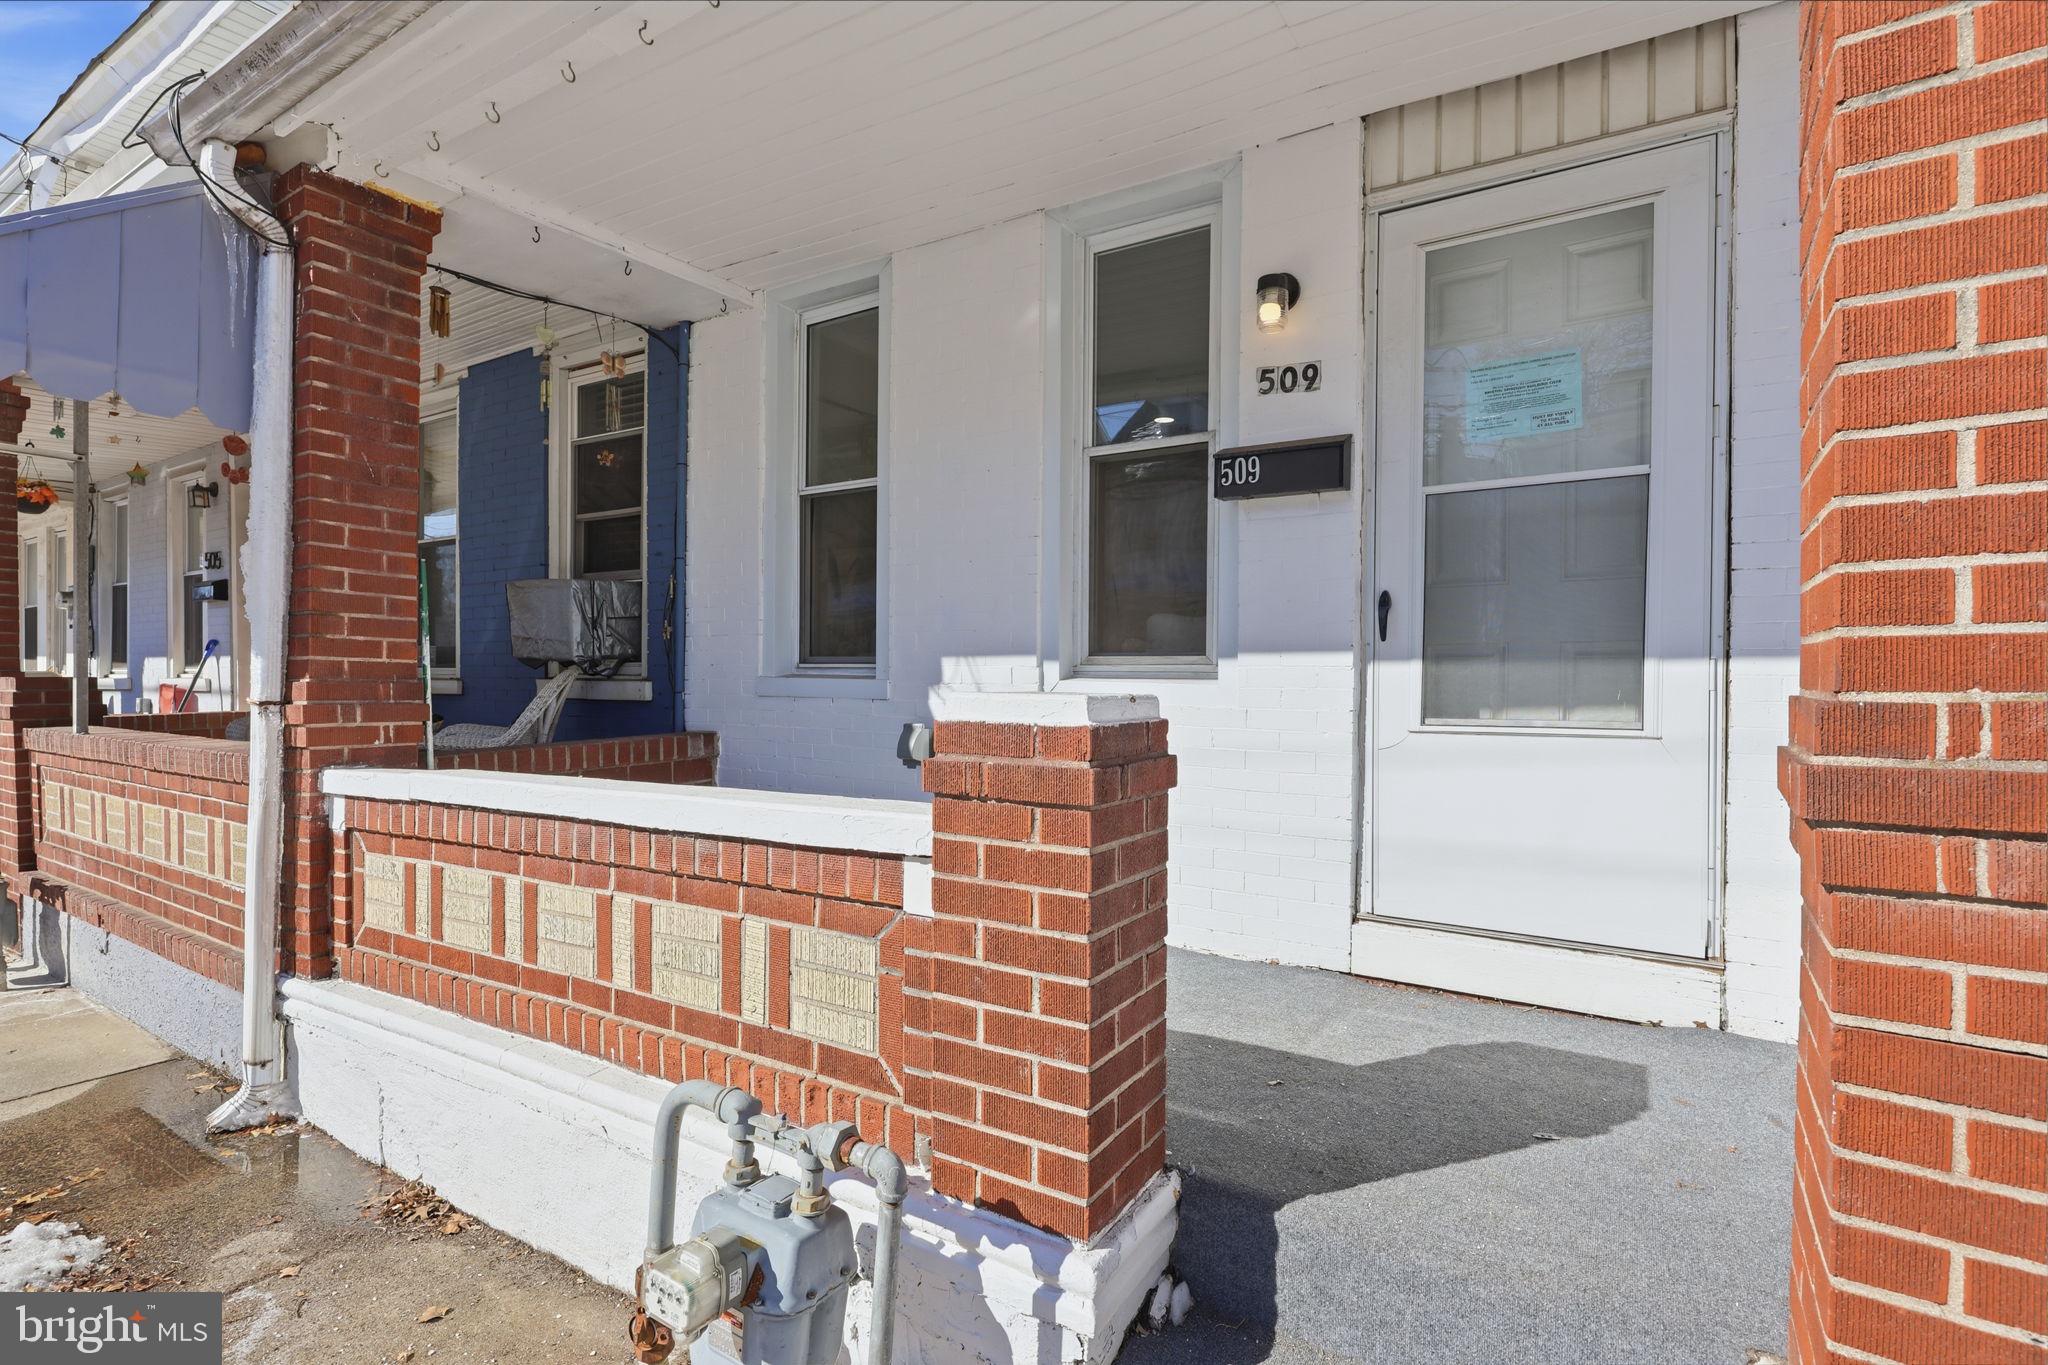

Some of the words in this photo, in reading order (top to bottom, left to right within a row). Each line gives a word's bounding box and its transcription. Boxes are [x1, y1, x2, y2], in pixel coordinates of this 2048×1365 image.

[1258, 363, 1319, 395] 509
[1220, 455, 1261, 486] 509
[204, 551, 222, 569] 505
